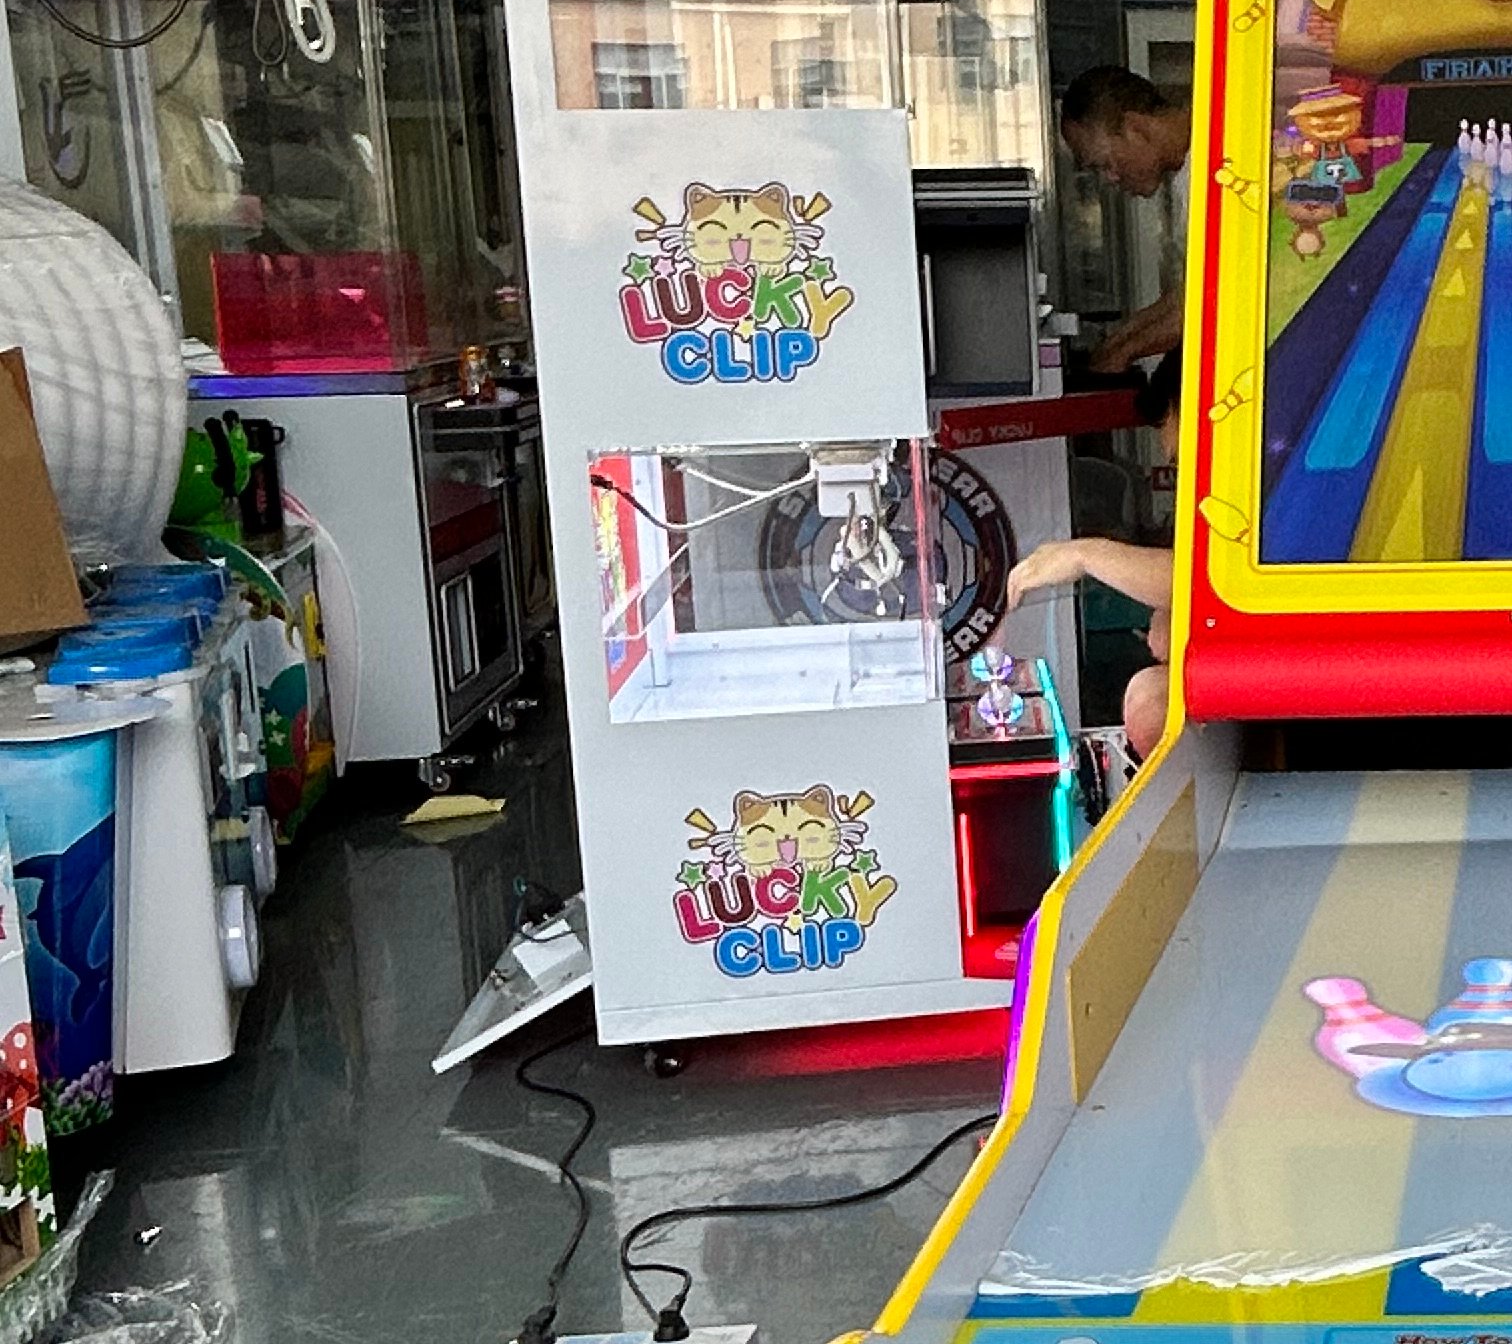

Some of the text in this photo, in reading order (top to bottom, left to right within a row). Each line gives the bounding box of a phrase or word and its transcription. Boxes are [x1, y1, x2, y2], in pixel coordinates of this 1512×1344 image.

[619, 267, 855, 344] LUCKY
[661, 329, 819, 385] CLIP
[673, 867, 898, 944] LUCKY
[713, 917, 866, 978] CLIP
